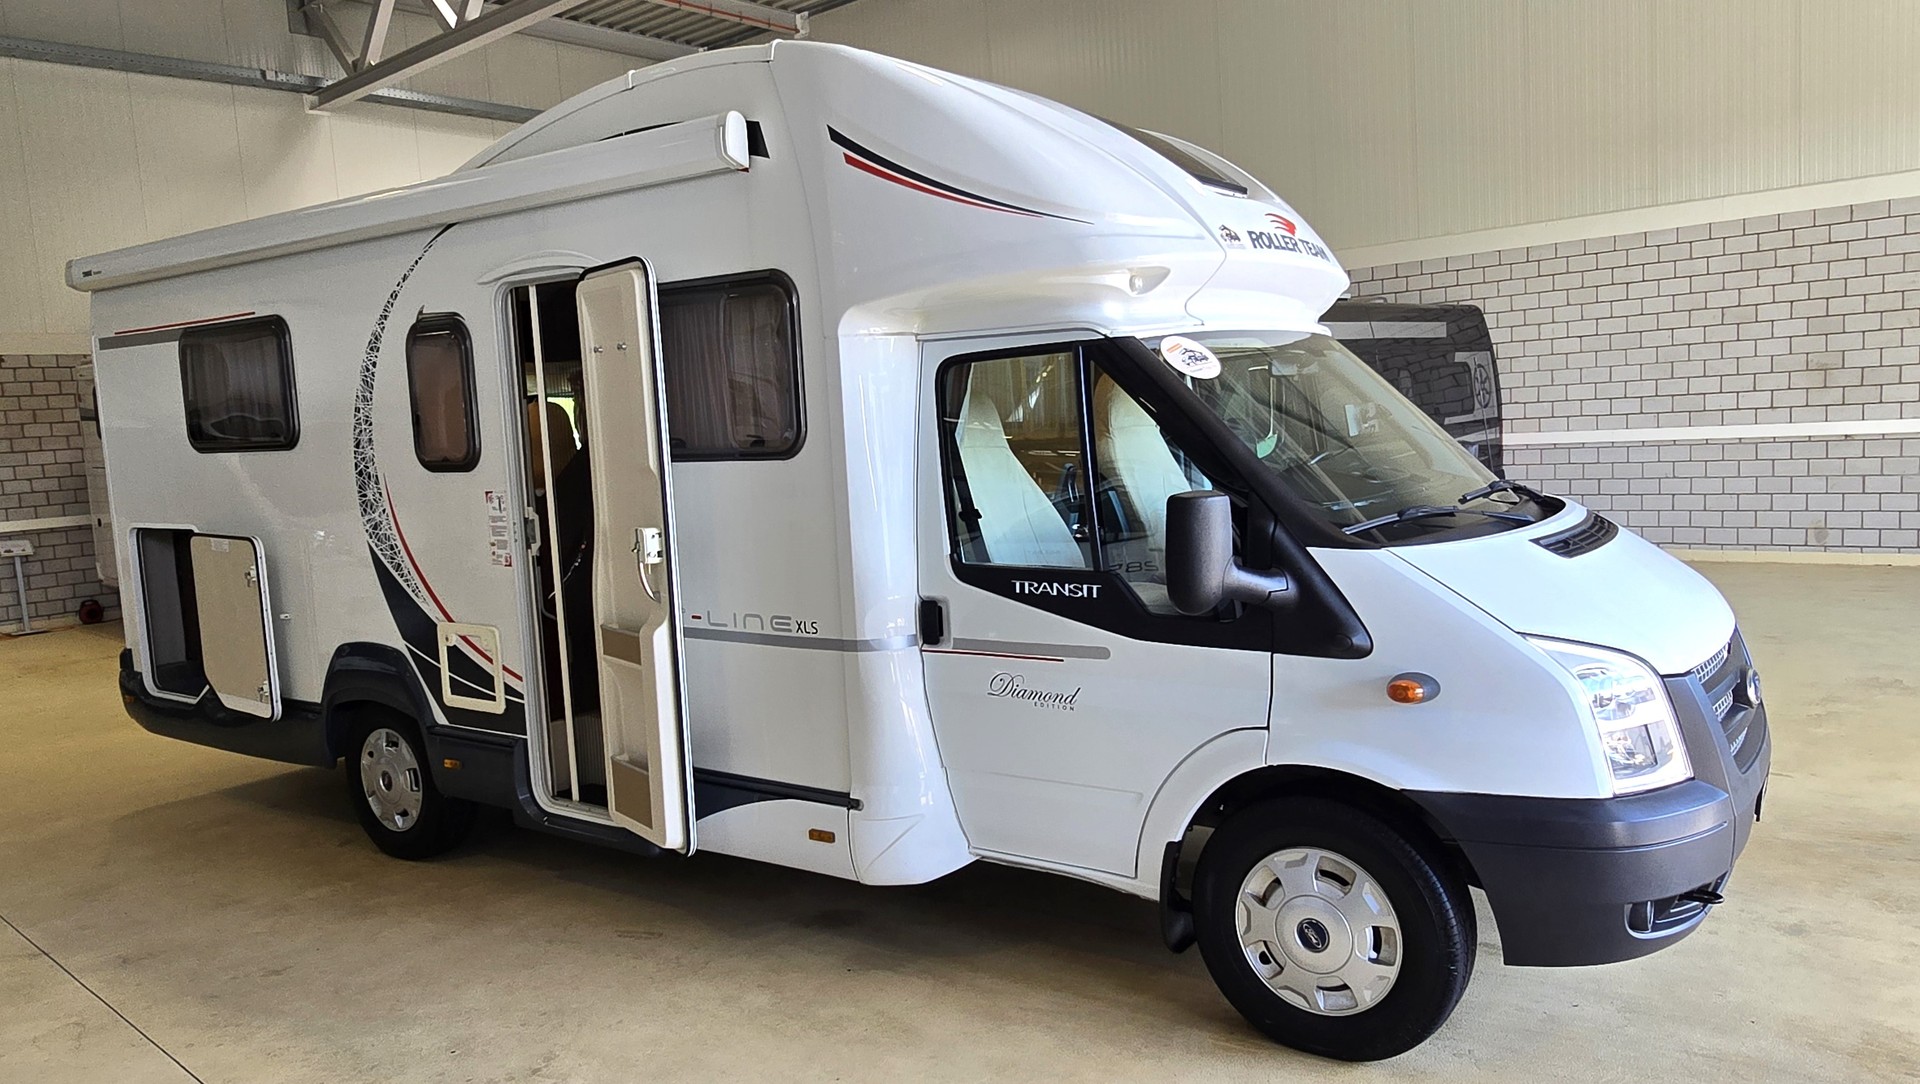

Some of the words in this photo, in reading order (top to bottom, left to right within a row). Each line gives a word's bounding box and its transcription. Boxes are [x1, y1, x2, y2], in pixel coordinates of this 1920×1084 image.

[1246, 230, 1302, 254] ROLLER
[1298, 238, 1331, 262] TEAM
[1011, 580, 1102, 599] TRANSIT
[682, 609, 793, 633] -LINE
[795, 619, 819, 635] XLS
[987, 672, 1081, 706] Diamond
[1034, 701, 1075, 712] EDITION
